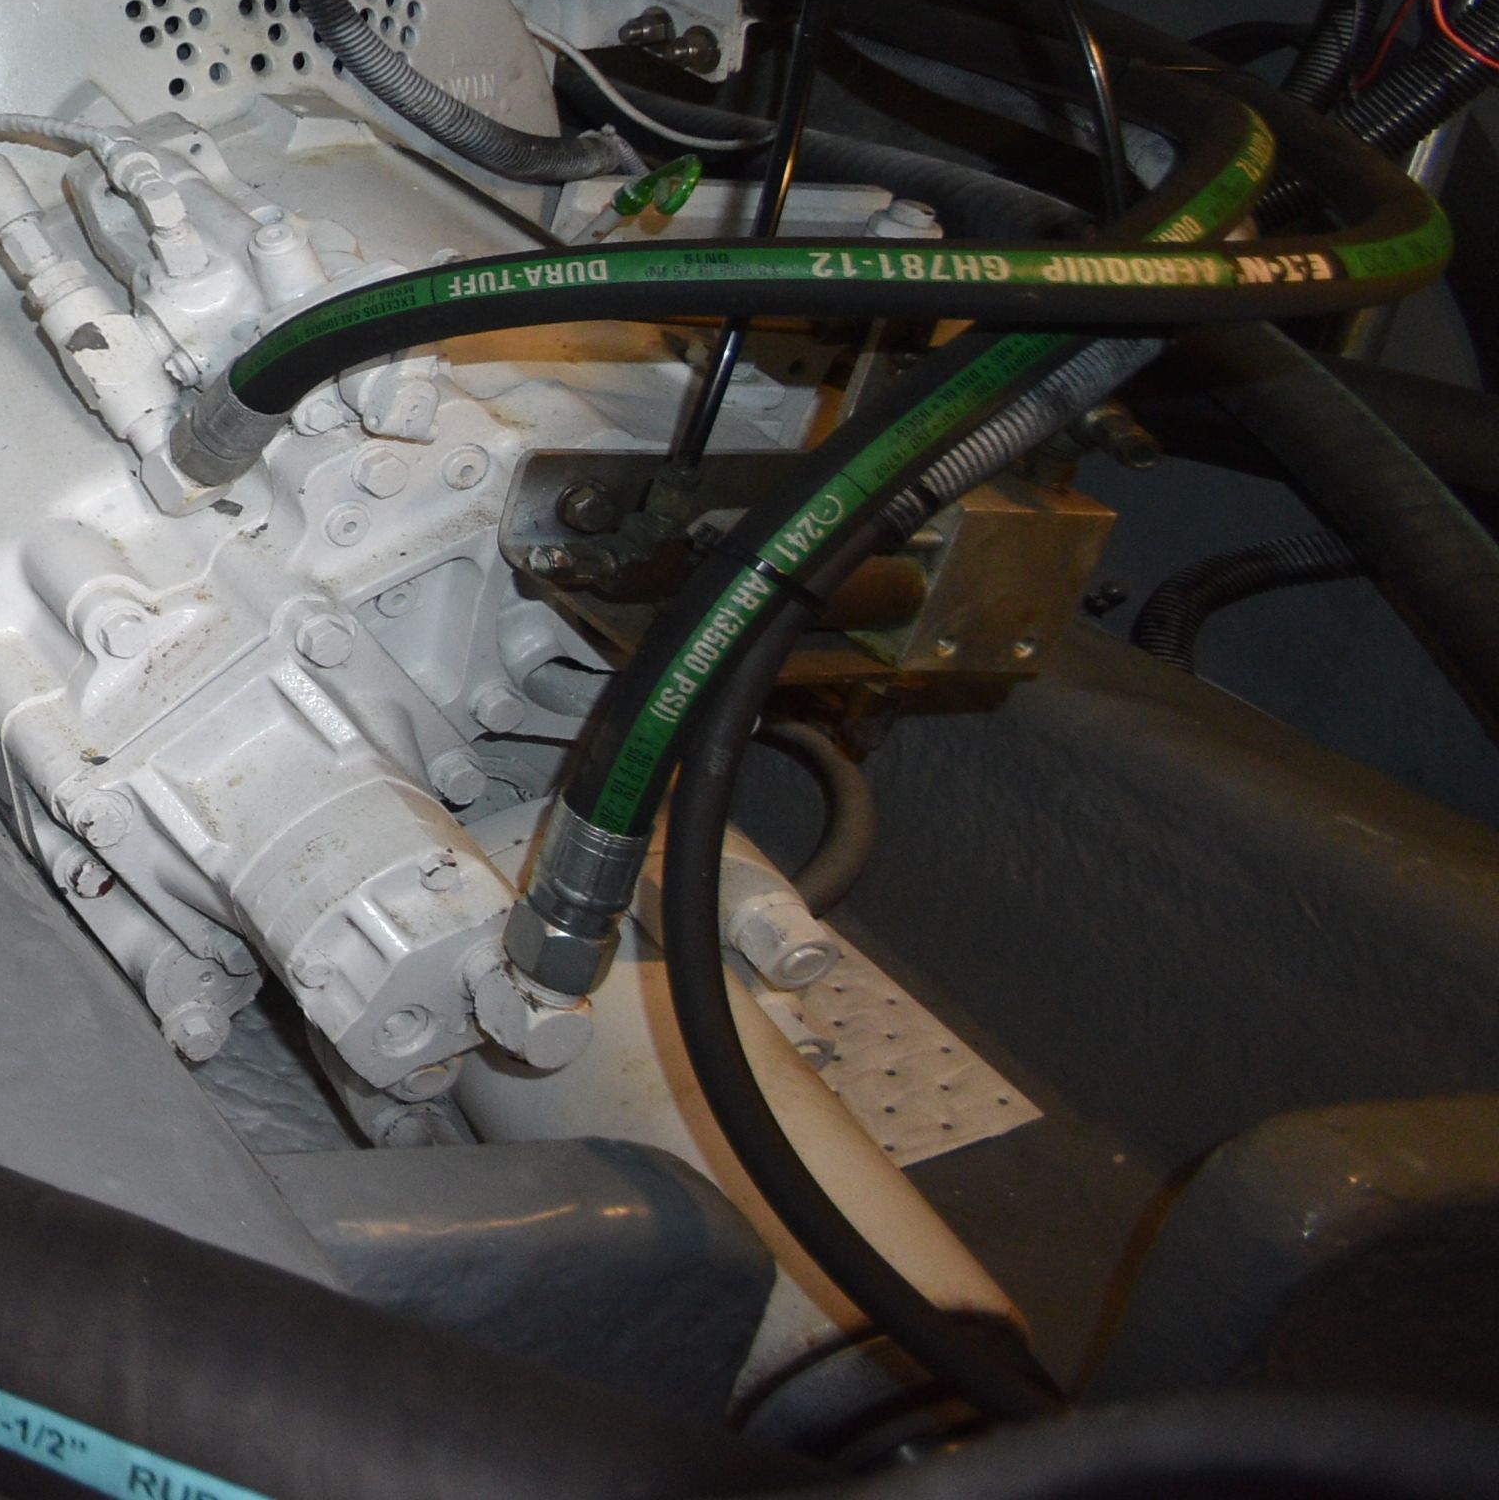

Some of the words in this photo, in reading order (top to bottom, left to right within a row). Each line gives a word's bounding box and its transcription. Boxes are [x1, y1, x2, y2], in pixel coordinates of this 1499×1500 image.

[446, 258, 608, 299] DURA-TUFF
[807, 250, 1009, 282] GH781-12
[1040, 255, 1217, 285] AEROQUIP
[776, 514, 827, 563] 241
[687, 606, 745, 676] (3500
